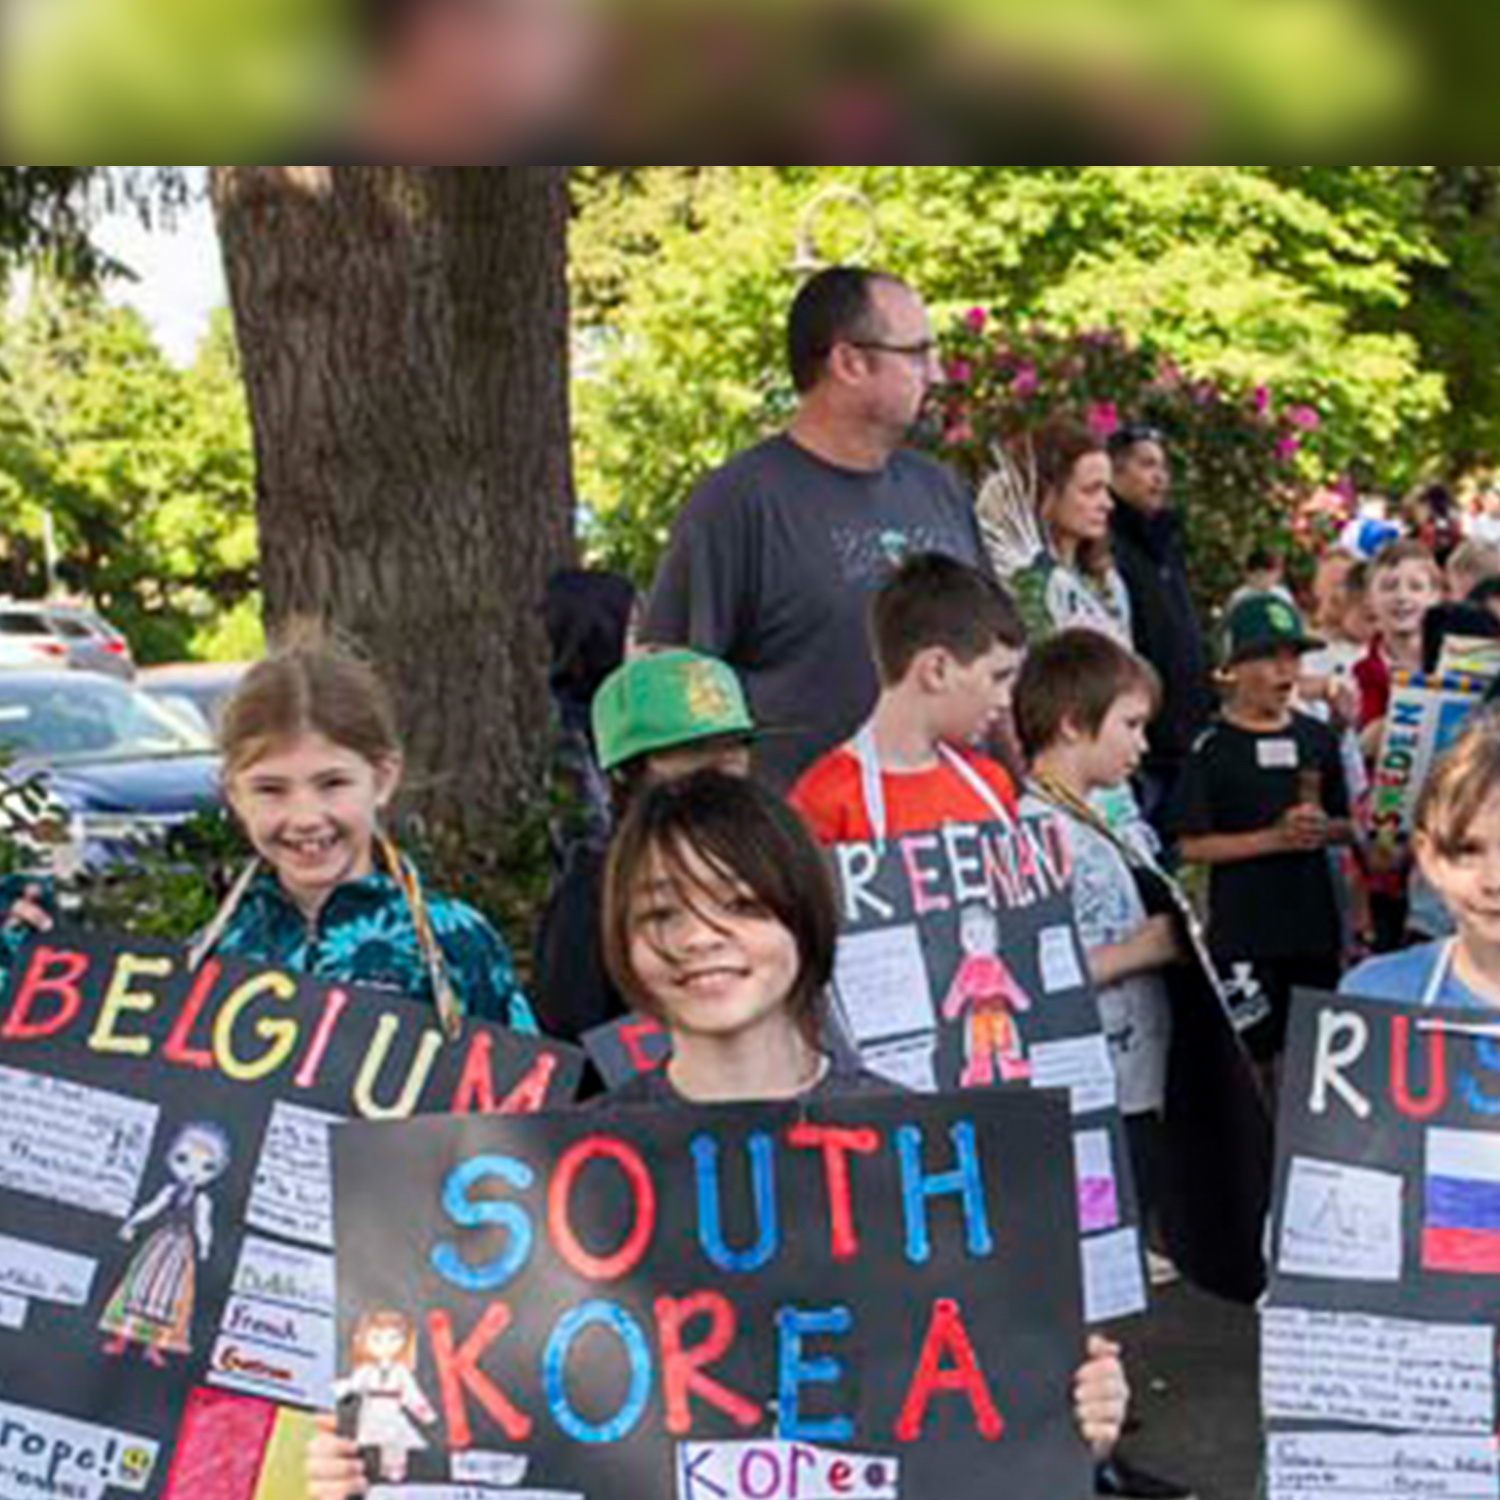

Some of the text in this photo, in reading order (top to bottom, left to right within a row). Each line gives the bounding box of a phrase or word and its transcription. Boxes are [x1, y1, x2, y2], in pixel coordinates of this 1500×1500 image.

[2, 946, 557, 1120] BELGIUM
[429, 1120, 994, 1290] SOUTH
[426, 1290, 1003, 1449] KOREA
